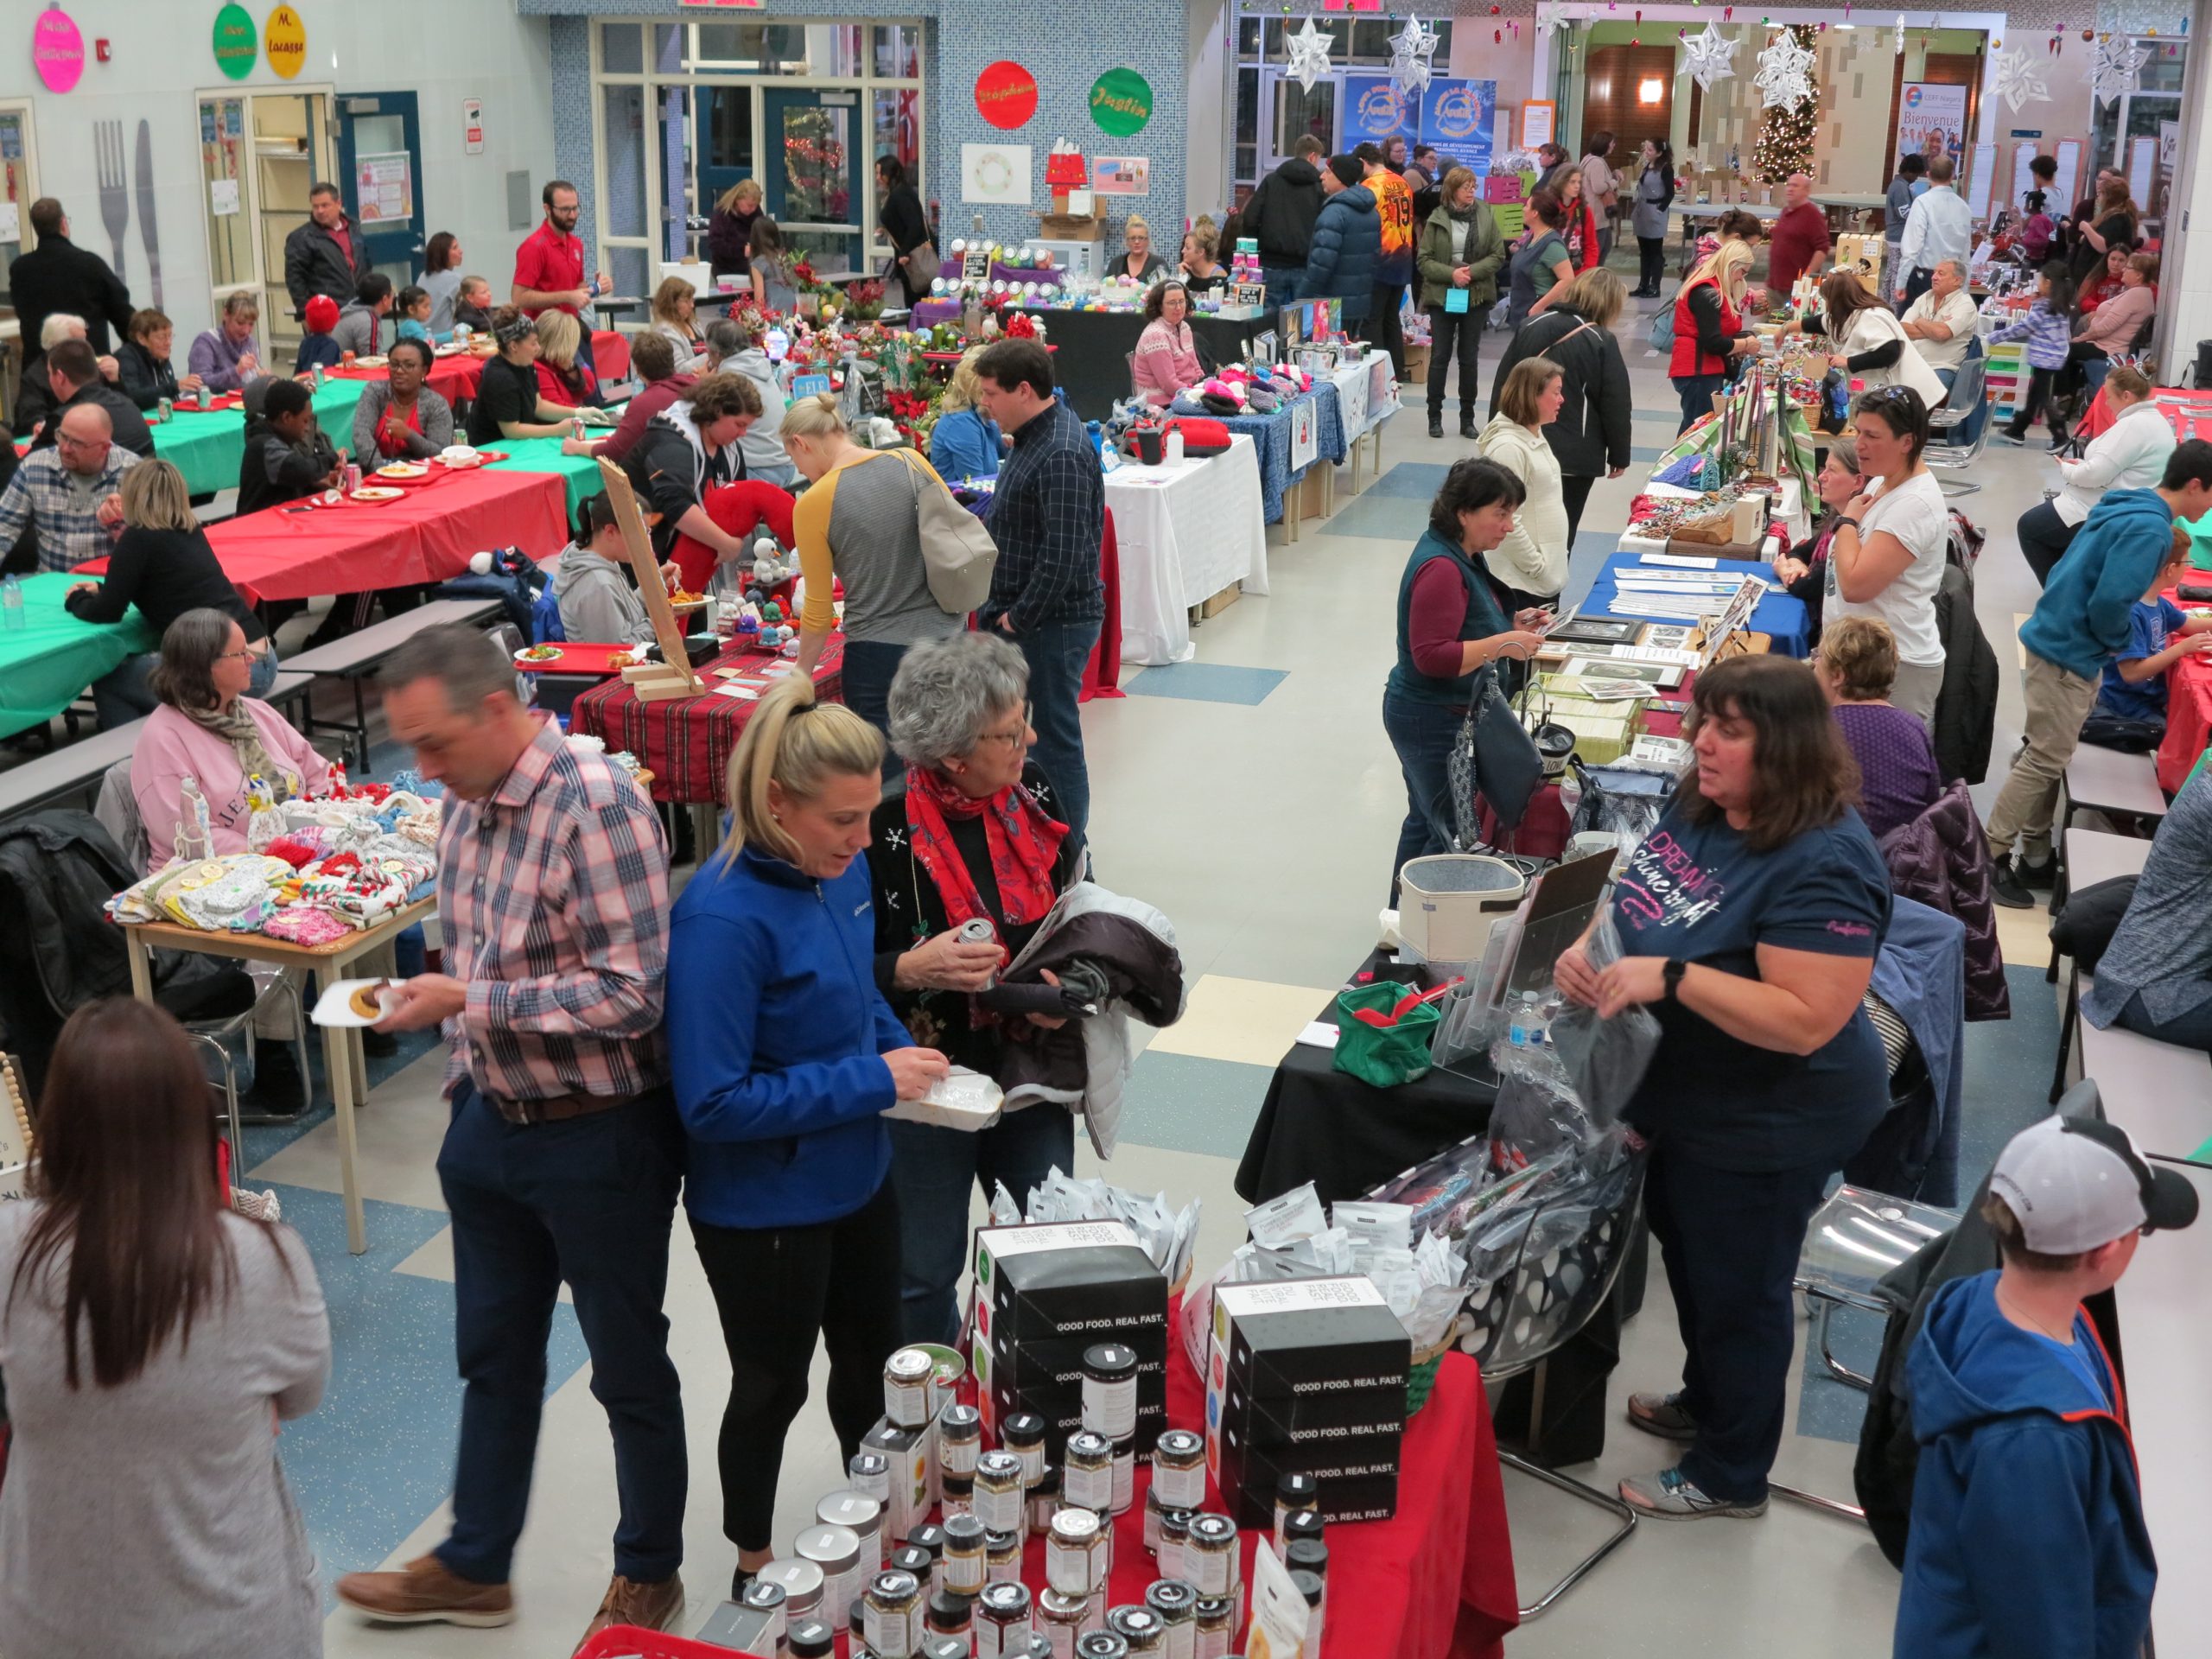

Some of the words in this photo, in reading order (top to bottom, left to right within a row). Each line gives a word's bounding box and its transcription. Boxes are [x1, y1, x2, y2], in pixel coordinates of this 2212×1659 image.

[1093, 87, 1147, 118] Justin
[1904, 111, 1960, 127] Bienvenue
[1393, 196, 1409, 227] 19
[1057, 1321, 1084, 1332] GOOD
[1086, 1319, 1113, 1329] FOOD.
[1116, 1318, 1138, 1327] REAL
[1140, 1313, 1164, 1324] FAST.
[1056, 1373, 1082, 1382] GOOD
[1138, 1362, 1160, 1372] FAST.
[1294, 1382, 1321, 1393] GOOD
[1324, 1380, 1351, 1390] FOOD.
[1354, 1377, 1377, 1387] REAL
[1380, 1375, 1404, 1385] FAST.
[1139, 1406, 1161, 1415] FAST.
[1291, 1430, 1318, 1440] GOOD
[1321, 1428, 1349, 1438] FOOD.
[1351, 1426, 1374, 1434] REAL
[1376, 1422, 1402, 1432] FAST.
[1139, 1452, 1154, 1461] FAS
[1315, 1469, 1343, 1478] FOOD.
[1345, 1466, 1368, 1476] REAL
[1370, 1463, 1395, 1473] FAST.
[1340, 1511, 1363, 1521] REAL
[1365, 1510, 1389, 1519] FAST.
